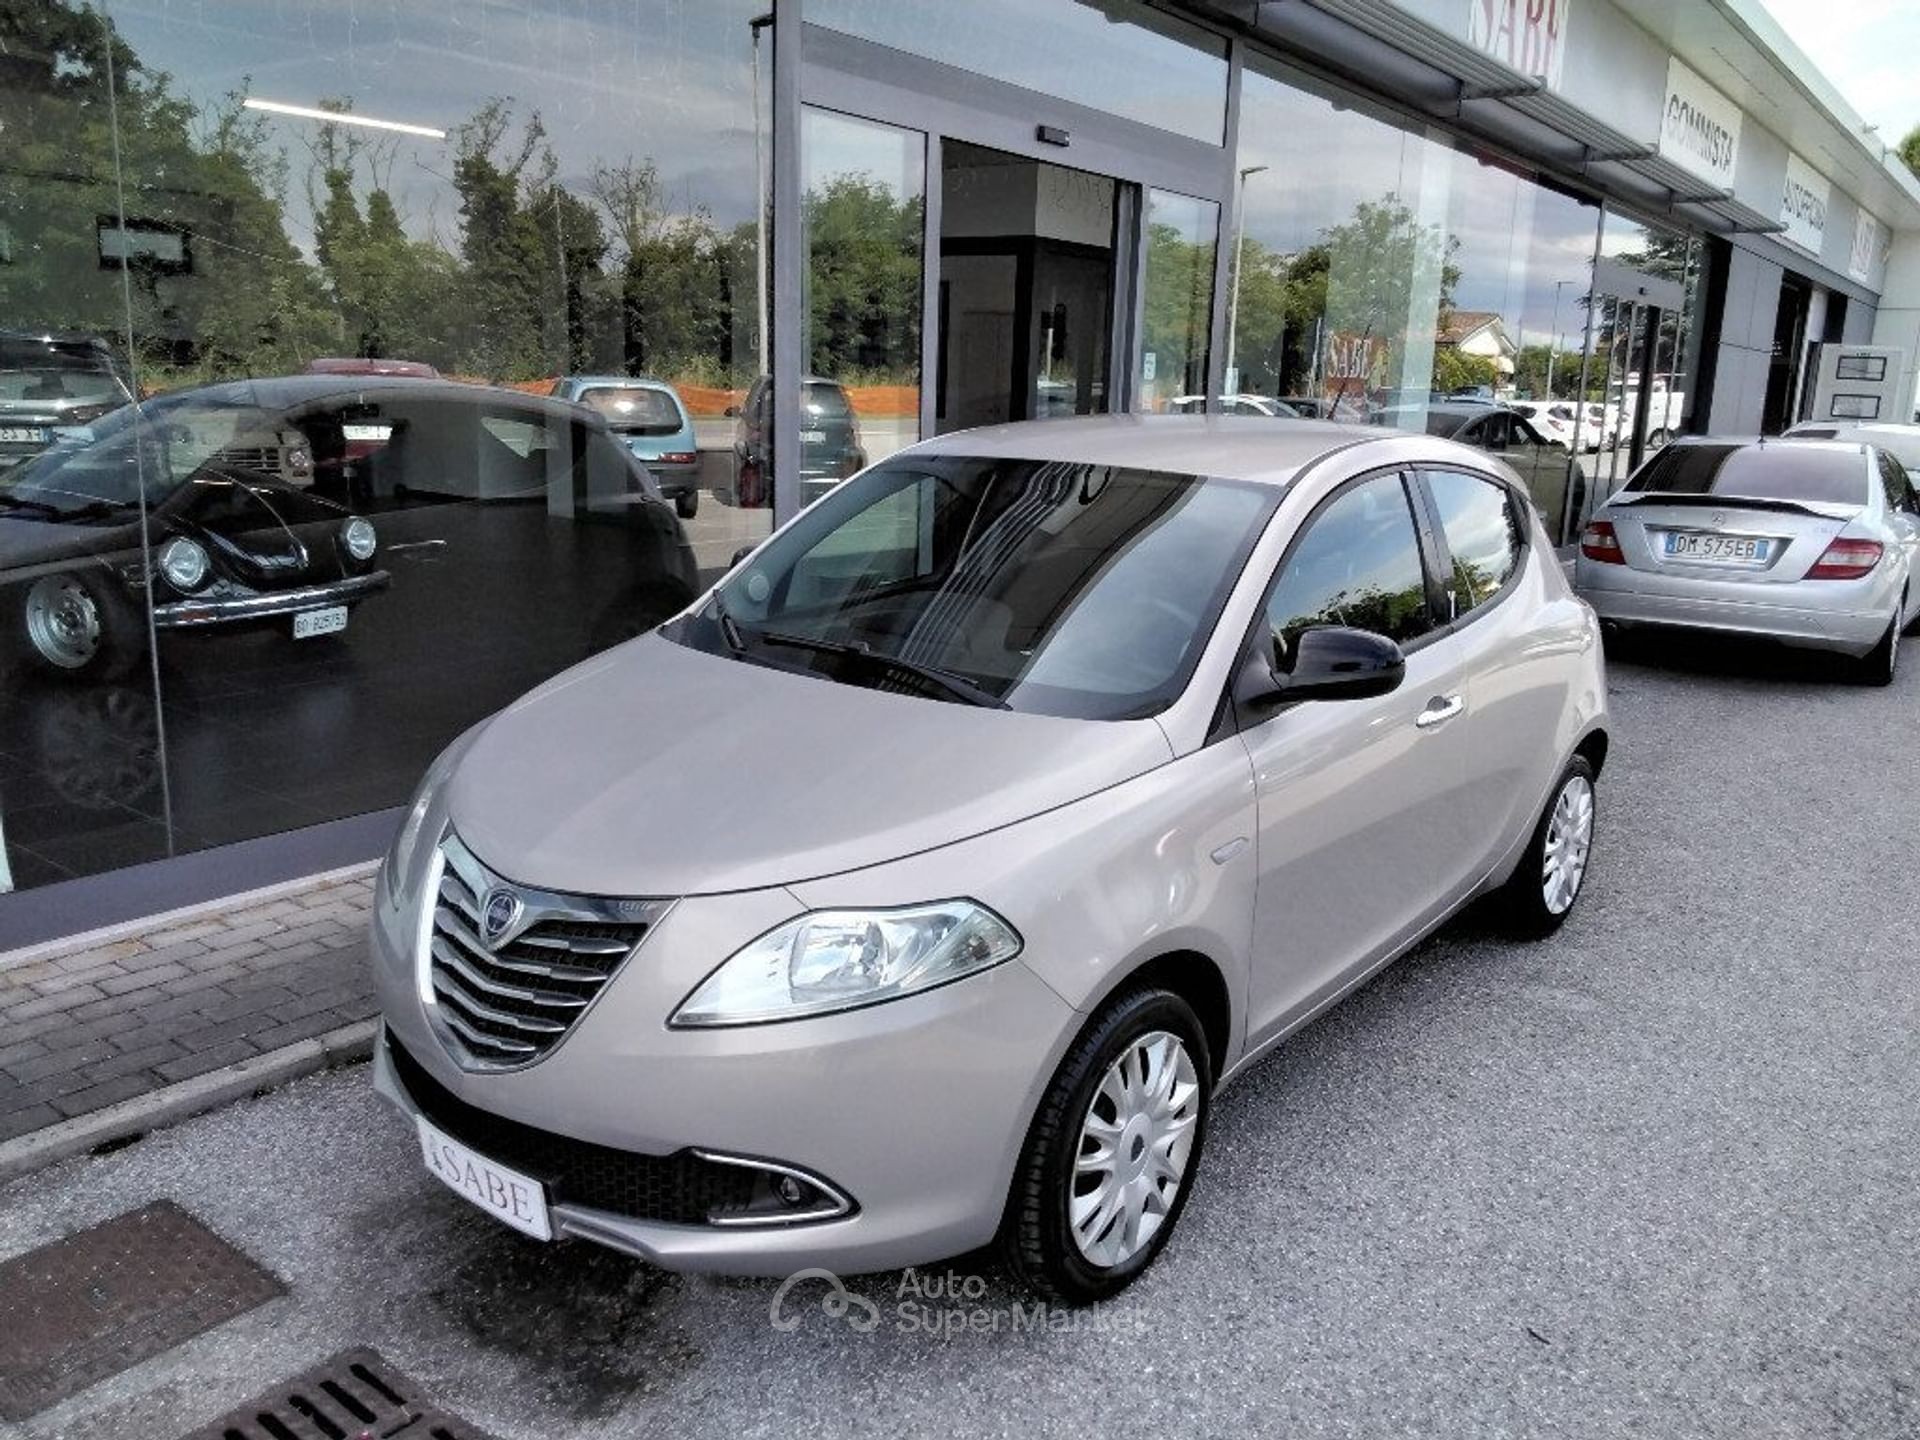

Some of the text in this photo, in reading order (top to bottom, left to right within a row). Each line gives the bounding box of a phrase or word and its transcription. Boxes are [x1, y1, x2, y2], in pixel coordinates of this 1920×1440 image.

[1676, 535, 1756, 557] DM 575EB
[442, 1145, 535, 1223] SABE
